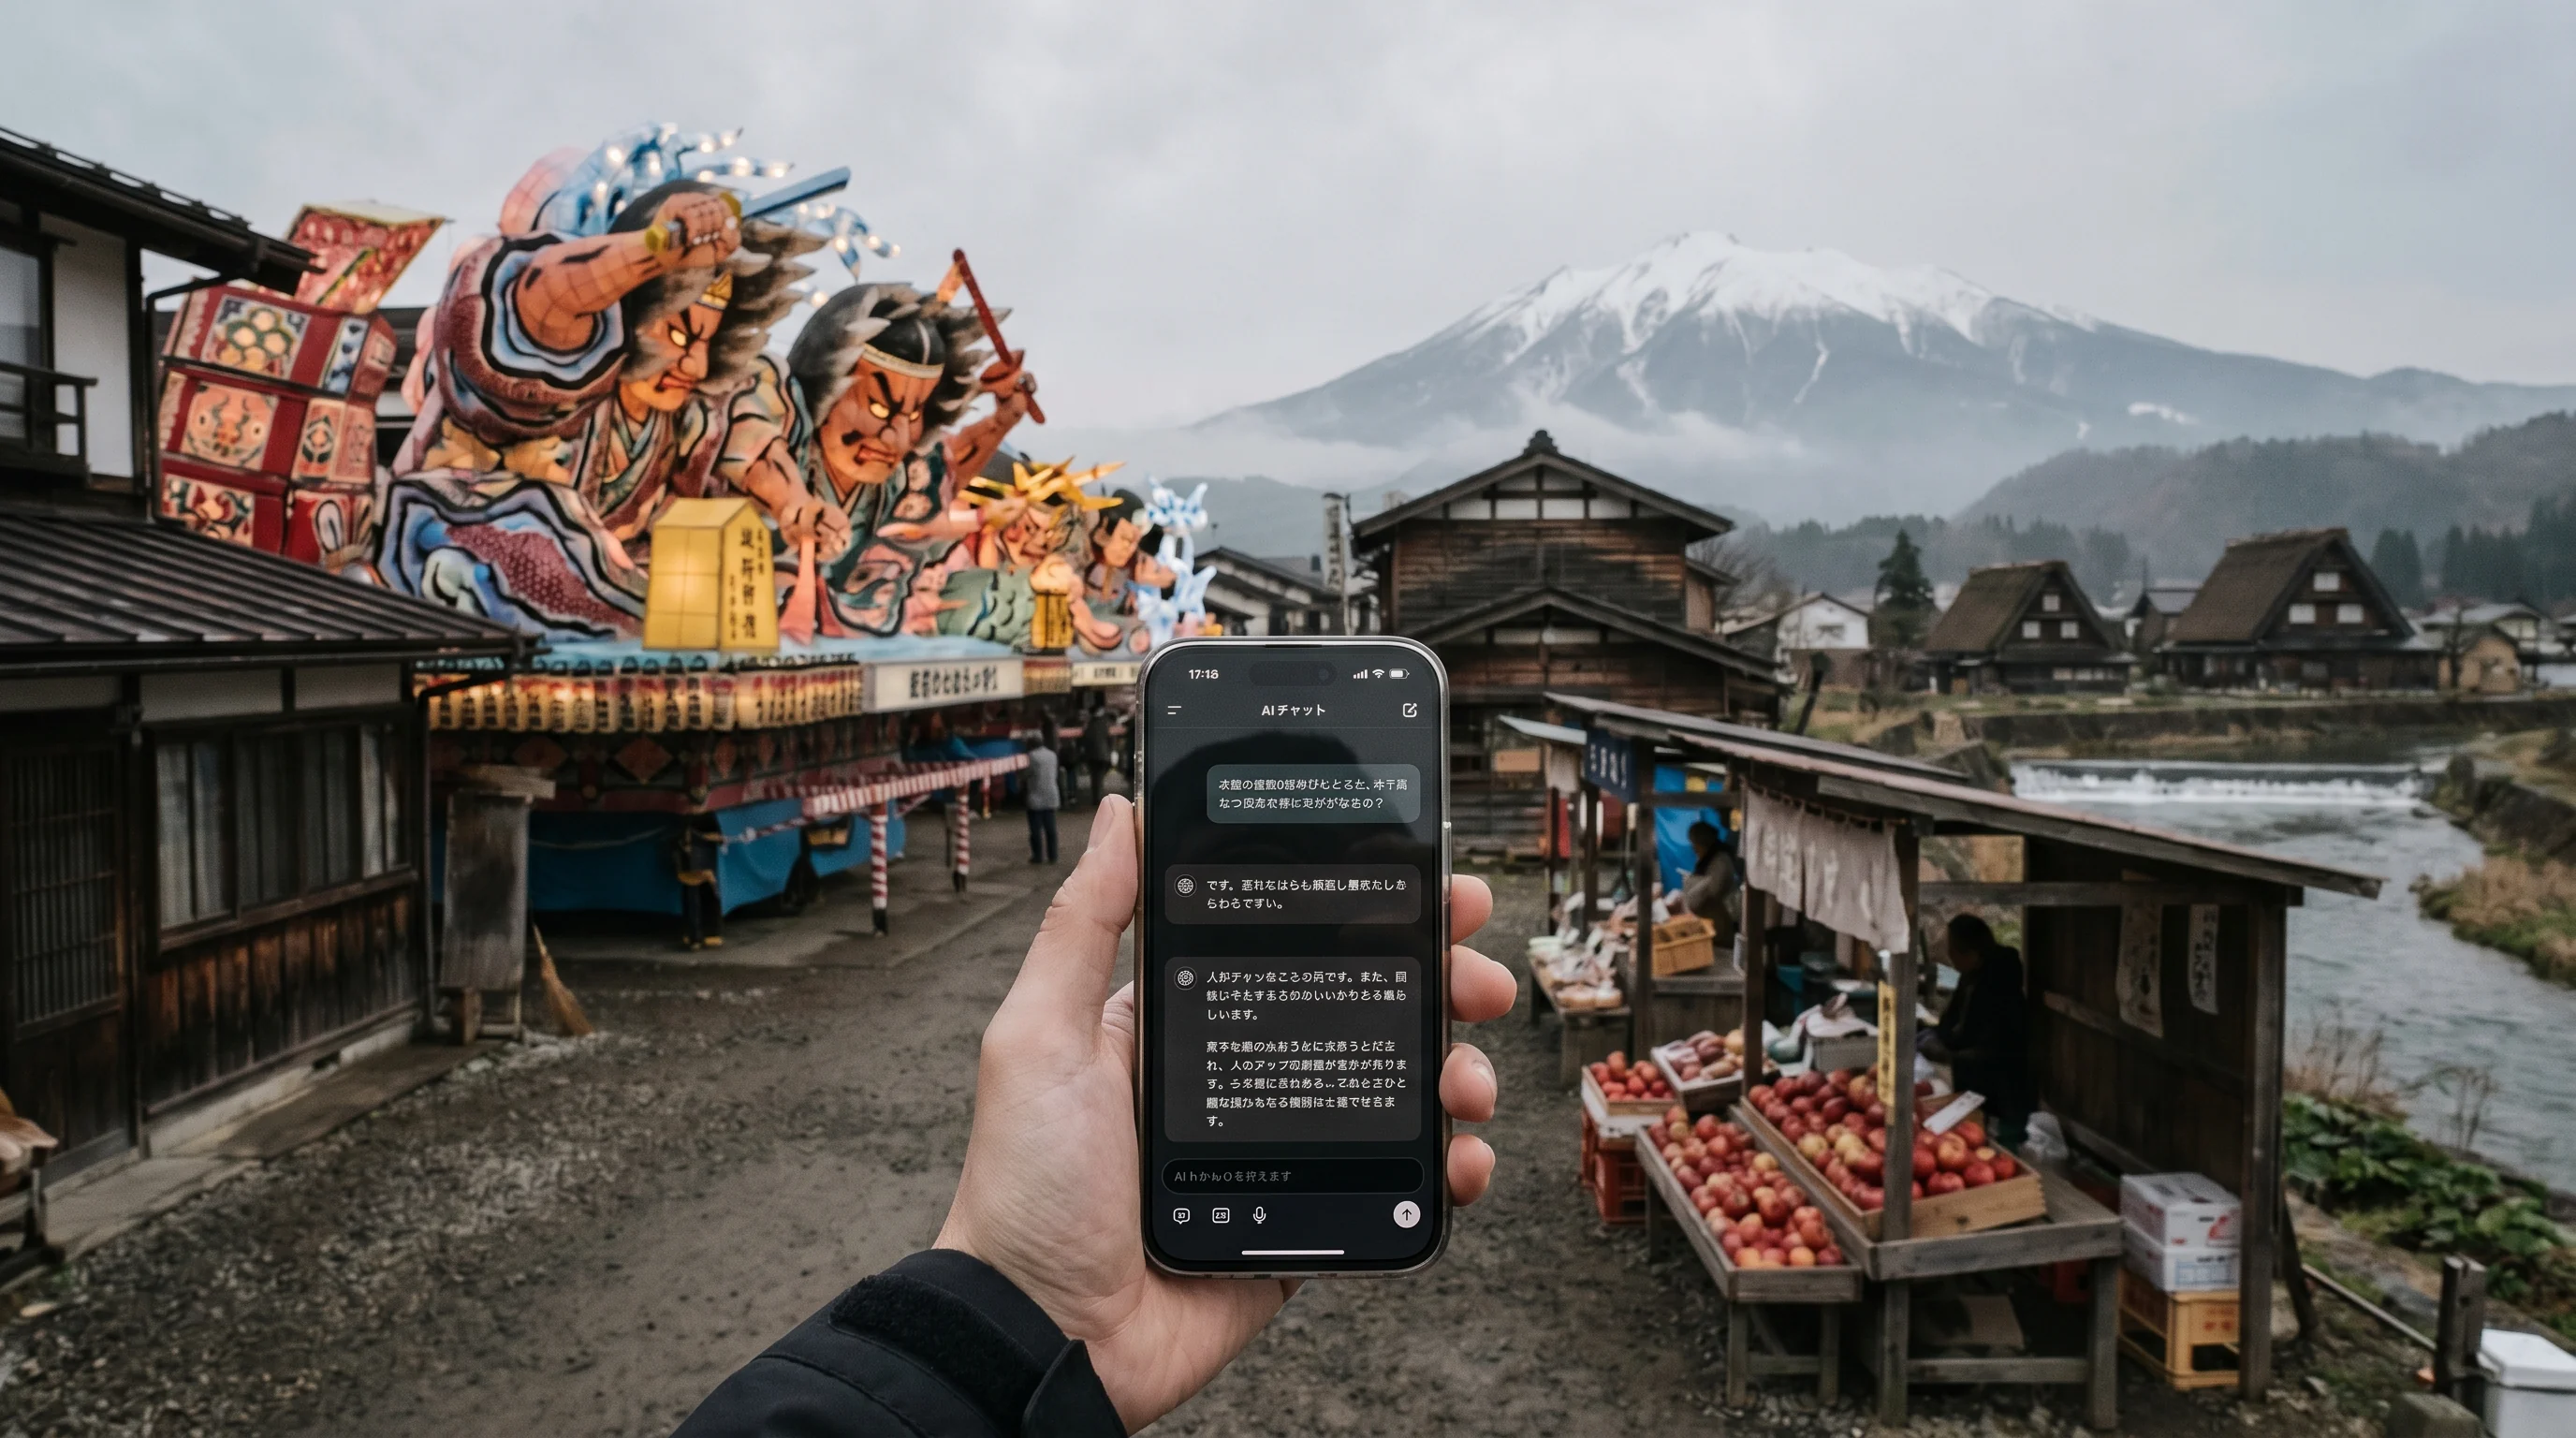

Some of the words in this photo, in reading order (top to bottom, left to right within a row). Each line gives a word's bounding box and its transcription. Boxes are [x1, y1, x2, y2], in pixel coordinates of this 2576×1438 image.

[1208, 1008, 1258, 1020] しいます。
[1206, 1115, 1223, 1127] す。
